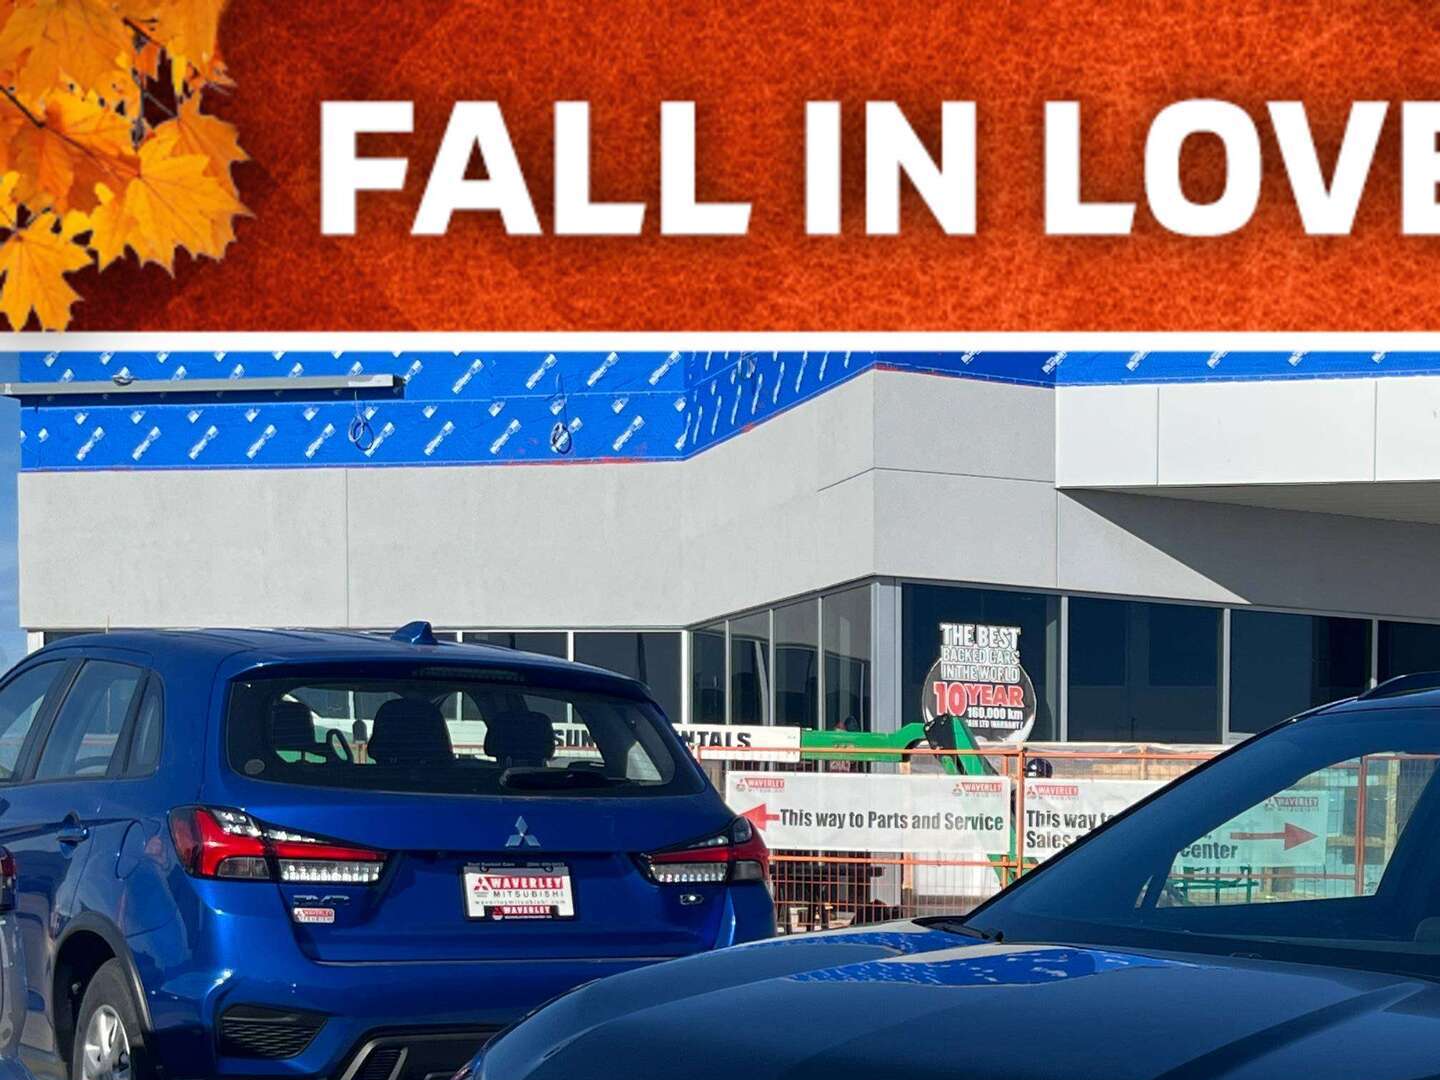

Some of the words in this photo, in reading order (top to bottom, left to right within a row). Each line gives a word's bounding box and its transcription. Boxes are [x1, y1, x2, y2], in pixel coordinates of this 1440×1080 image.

[940, 623, 976, 646] THE
[976, 625, 1021, 649] BEST
[942, 646, 987, 662] BACKED
[989, 648, 1020, 664] CARS
[942, 664, 955, 680] IN
[955, 665, 978, 681] THE
[978, 666, 1020, 683] WORLD
[934, 682, 967, 716] 10
[966, 683, 1024, 707] YEAR
[1008, 708, 1024, 720] km
[780, 808, 812, 828] This
[816, 812, 845, 829] way
[849, 811, 863, 828] to
[868, 811, 908, 829] Parts
[911, 811, 940, 830] and
[944, 812, 1004, 831] Service
[1026, 810, 1060, 828] This
[1064, 814, 1097, 830] way
[1026, 830, 1072, 849] Sales
[490, 878, 562, 889] WAVERLEY
[493, 890, 564, 898] MITSUBISHI
